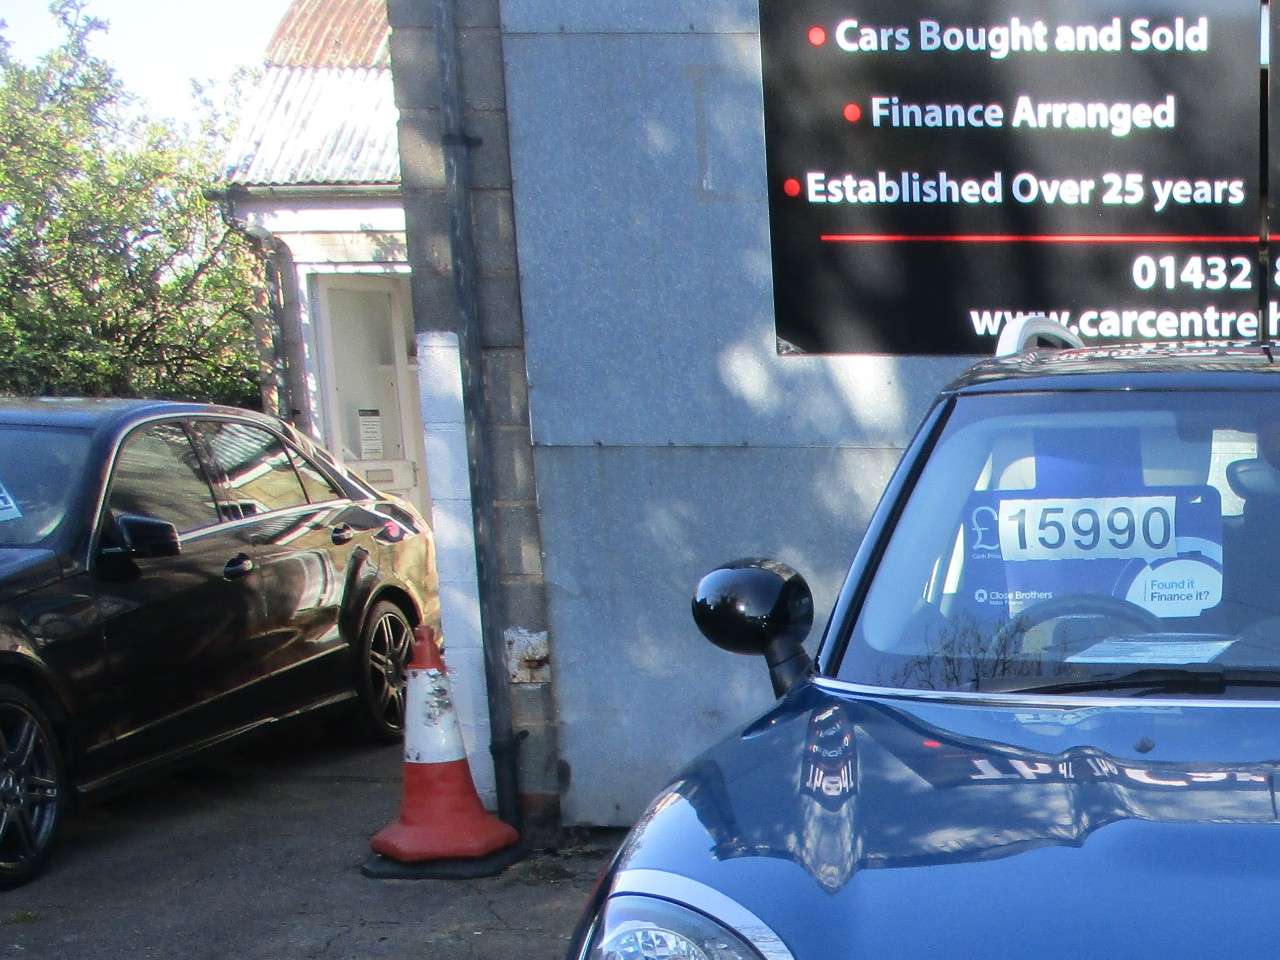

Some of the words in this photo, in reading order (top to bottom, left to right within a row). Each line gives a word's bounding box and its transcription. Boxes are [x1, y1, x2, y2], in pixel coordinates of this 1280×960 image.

[835, 18, 910, 52] Cars
[919, 16, 1048, 59] Bought
[1054, 17, 1121, 52] and
[1131, 16, 1209, 52] Sold
[871, 96, 1003, 127] Finance
[1012, 95, 1175, 137] Arranged
[806, 172, 1002, 204] Established
[1012, 172, 1095, 204] Over
[1102, 173, 1144, 205] 25
[1152, 180, 1245, 212] years
[1132, 255, 1252, 290] 01432
[1008, 506, 1171, 551] 15990
[989, 591, 1013, 600] Close
[1015, 590, 1053, 600] Brothers
[1151, 579, 1185, 589] Found
[1187, 578, 1195, 589] it
[1151, 591, 1193, 601] Finance
[1195, 590, 1210, 601] it?
